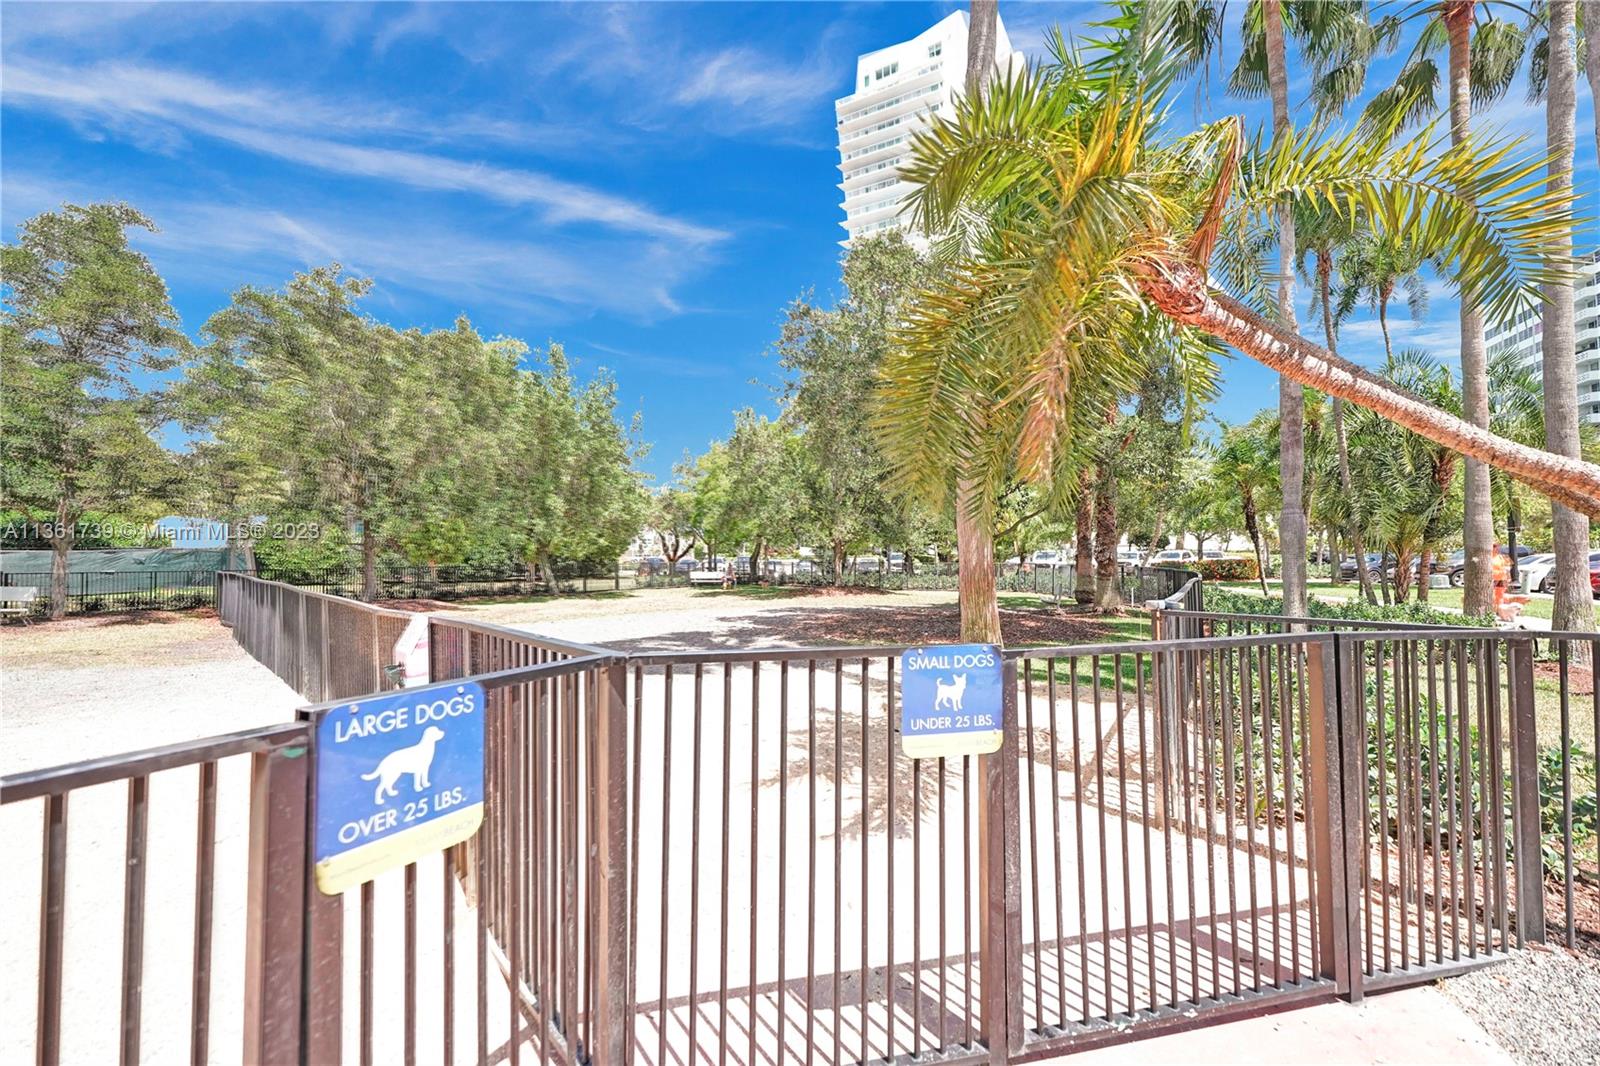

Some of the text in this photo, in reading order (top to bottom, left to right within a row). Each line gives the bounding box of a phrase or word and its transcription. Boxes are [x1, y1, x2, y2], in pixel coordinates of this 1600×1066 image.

[908, 654, 994, 670] SMALL DOGS
[336, 694, 474, 743] LARGE DOGS
[911, 715, 995, 730] UNDER 25 LBS.
[338, 809, 398, 844] OVER
[404, 798, 428, 822] 25
[434, 787, 467, 811] LBS.
